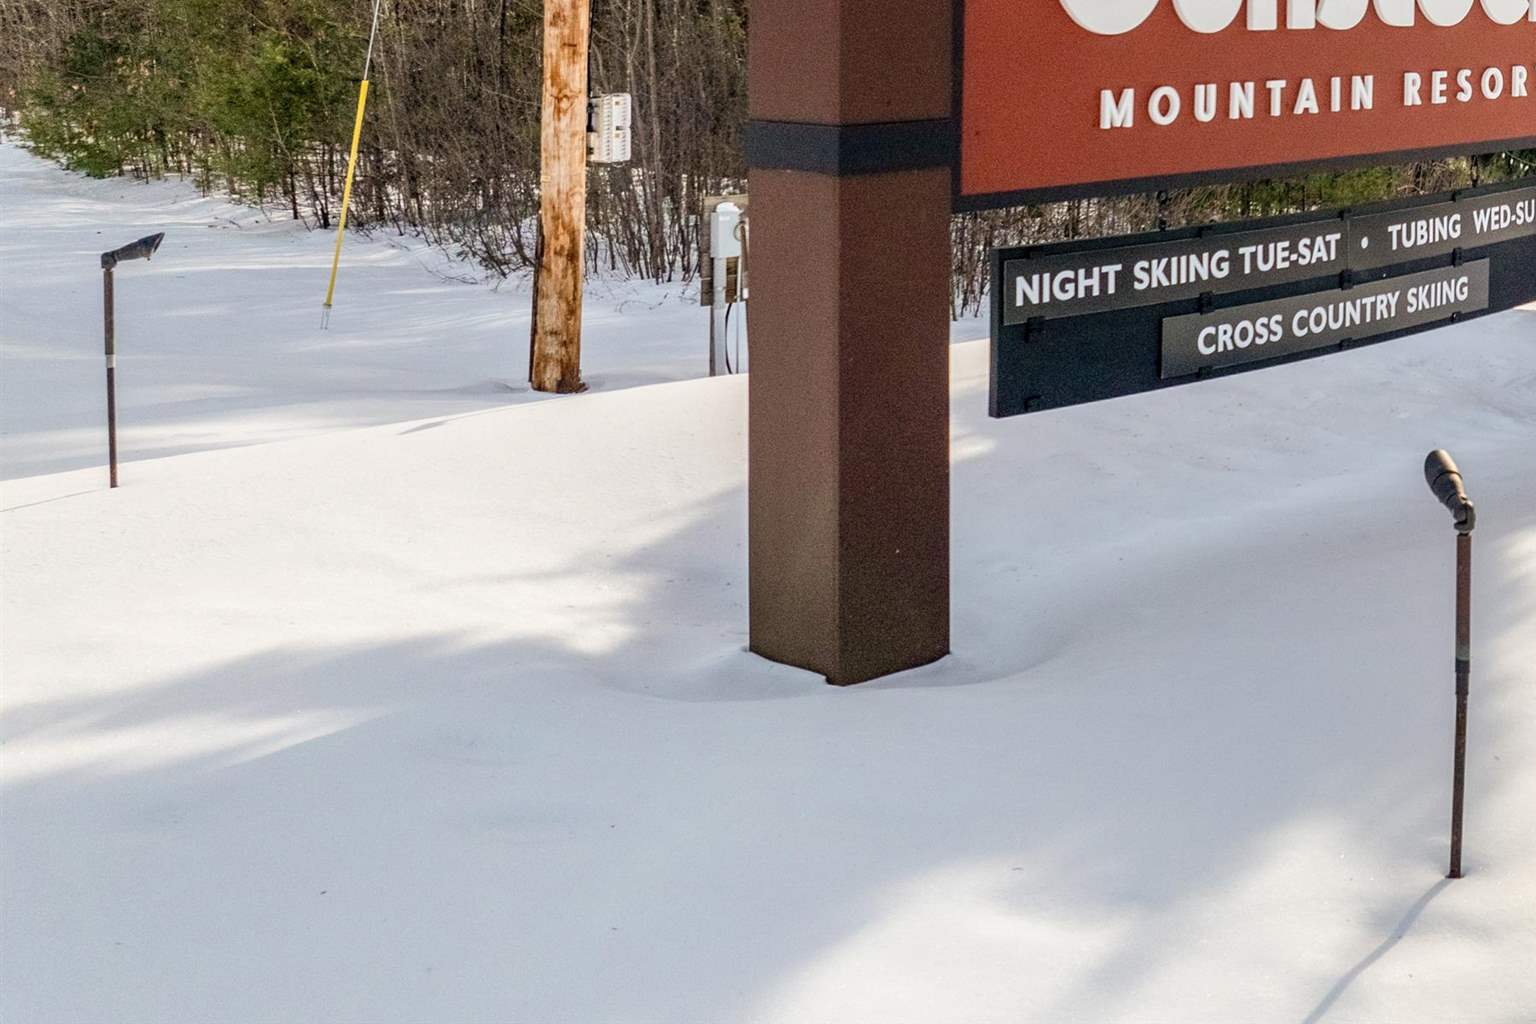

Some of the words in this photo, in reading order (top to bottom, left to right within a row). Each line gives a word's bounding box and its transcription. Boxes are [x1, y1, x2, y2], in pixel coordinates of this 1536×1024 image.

[1100, 75, 1375, 130] MOUNTAIN
[1015, 264, 1122, 307] NIGHT
[1133, 249, 1230, 291] SKIING
[1238, 233, 1342, 275] TUE-SAT
[1387, 213, 1462, 251] TUBING
[1197, 313, 1284, 356] CROSS
[1291, 290, 1400, 338] COUNTRY
[1406, 275, 1470, 314] SKIING
